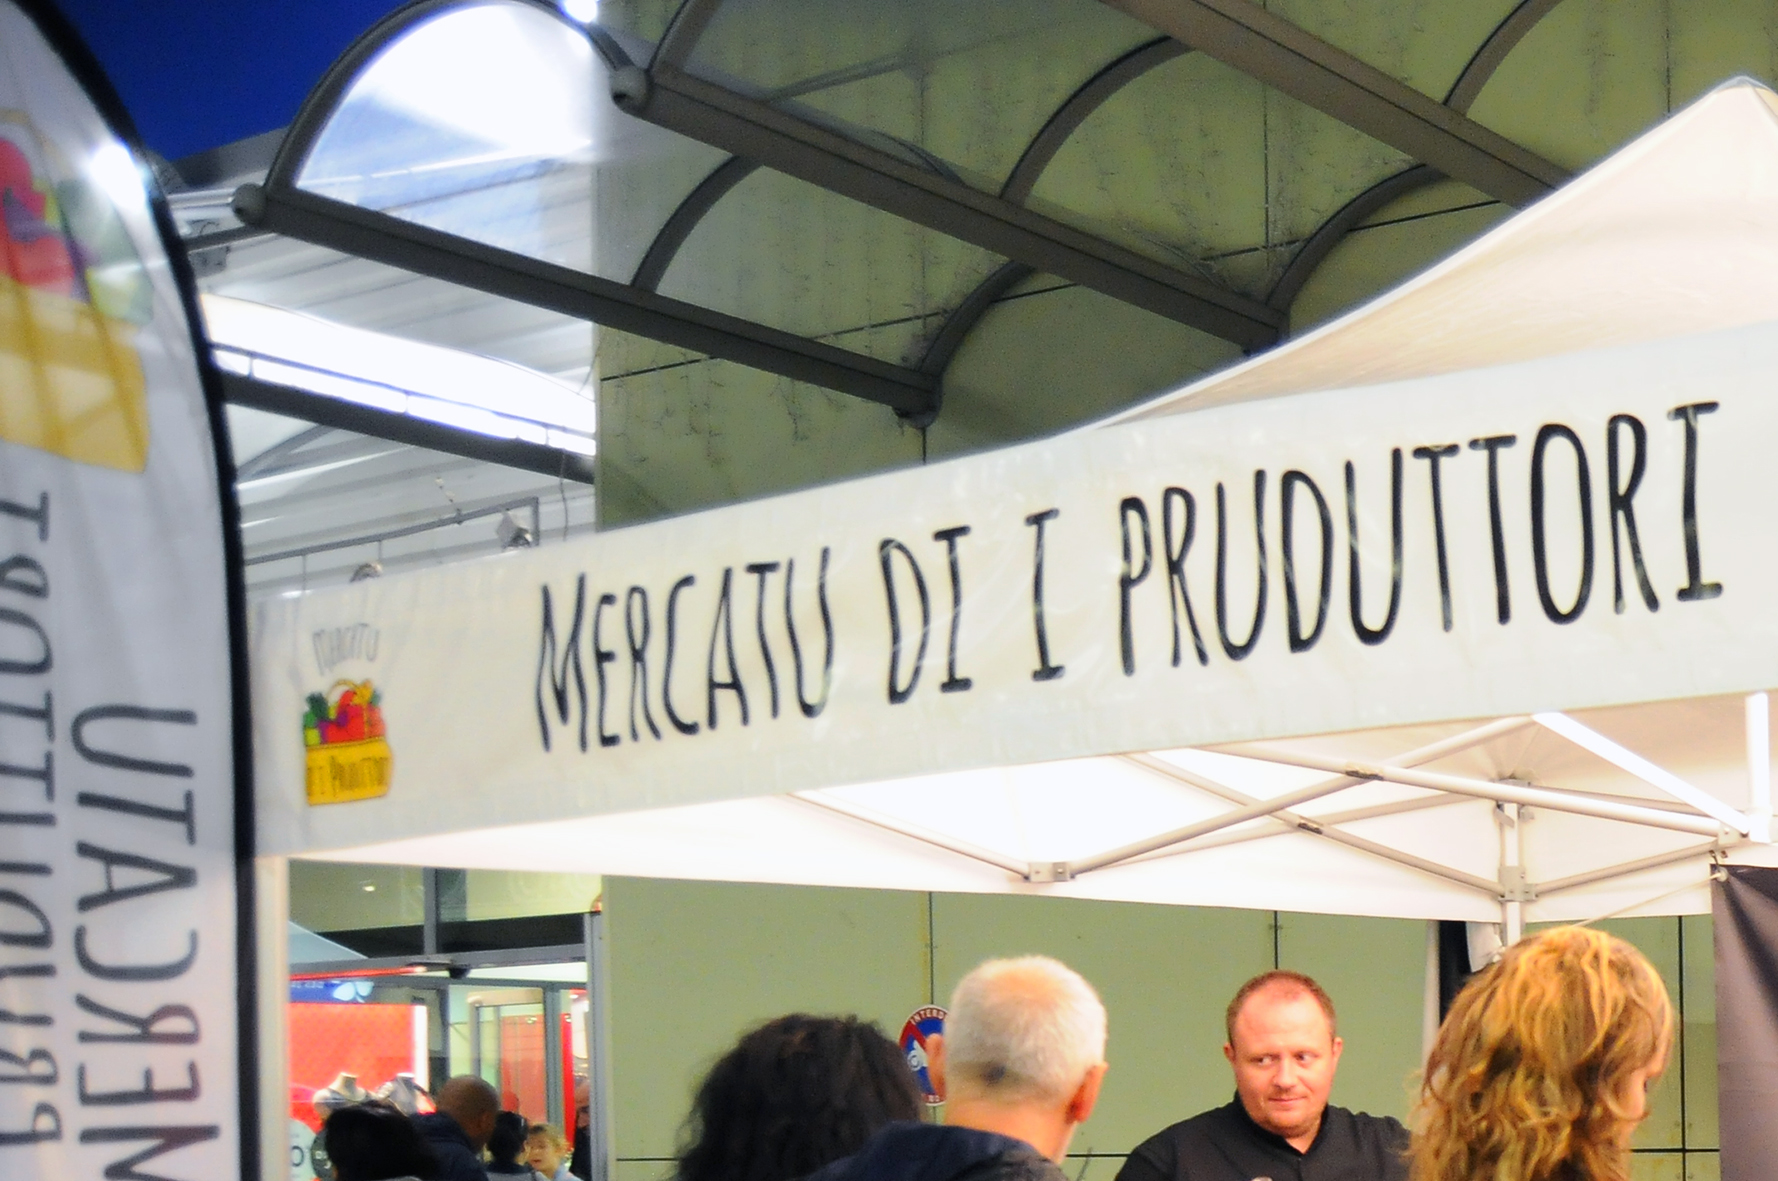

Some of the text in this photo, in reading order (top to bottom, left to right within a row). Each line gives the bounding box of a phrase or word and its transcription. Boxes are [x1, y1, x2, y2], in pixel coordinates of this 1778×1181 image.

[537, 401, 1724, 754] MERCATU DI I PRUDUTTORI
